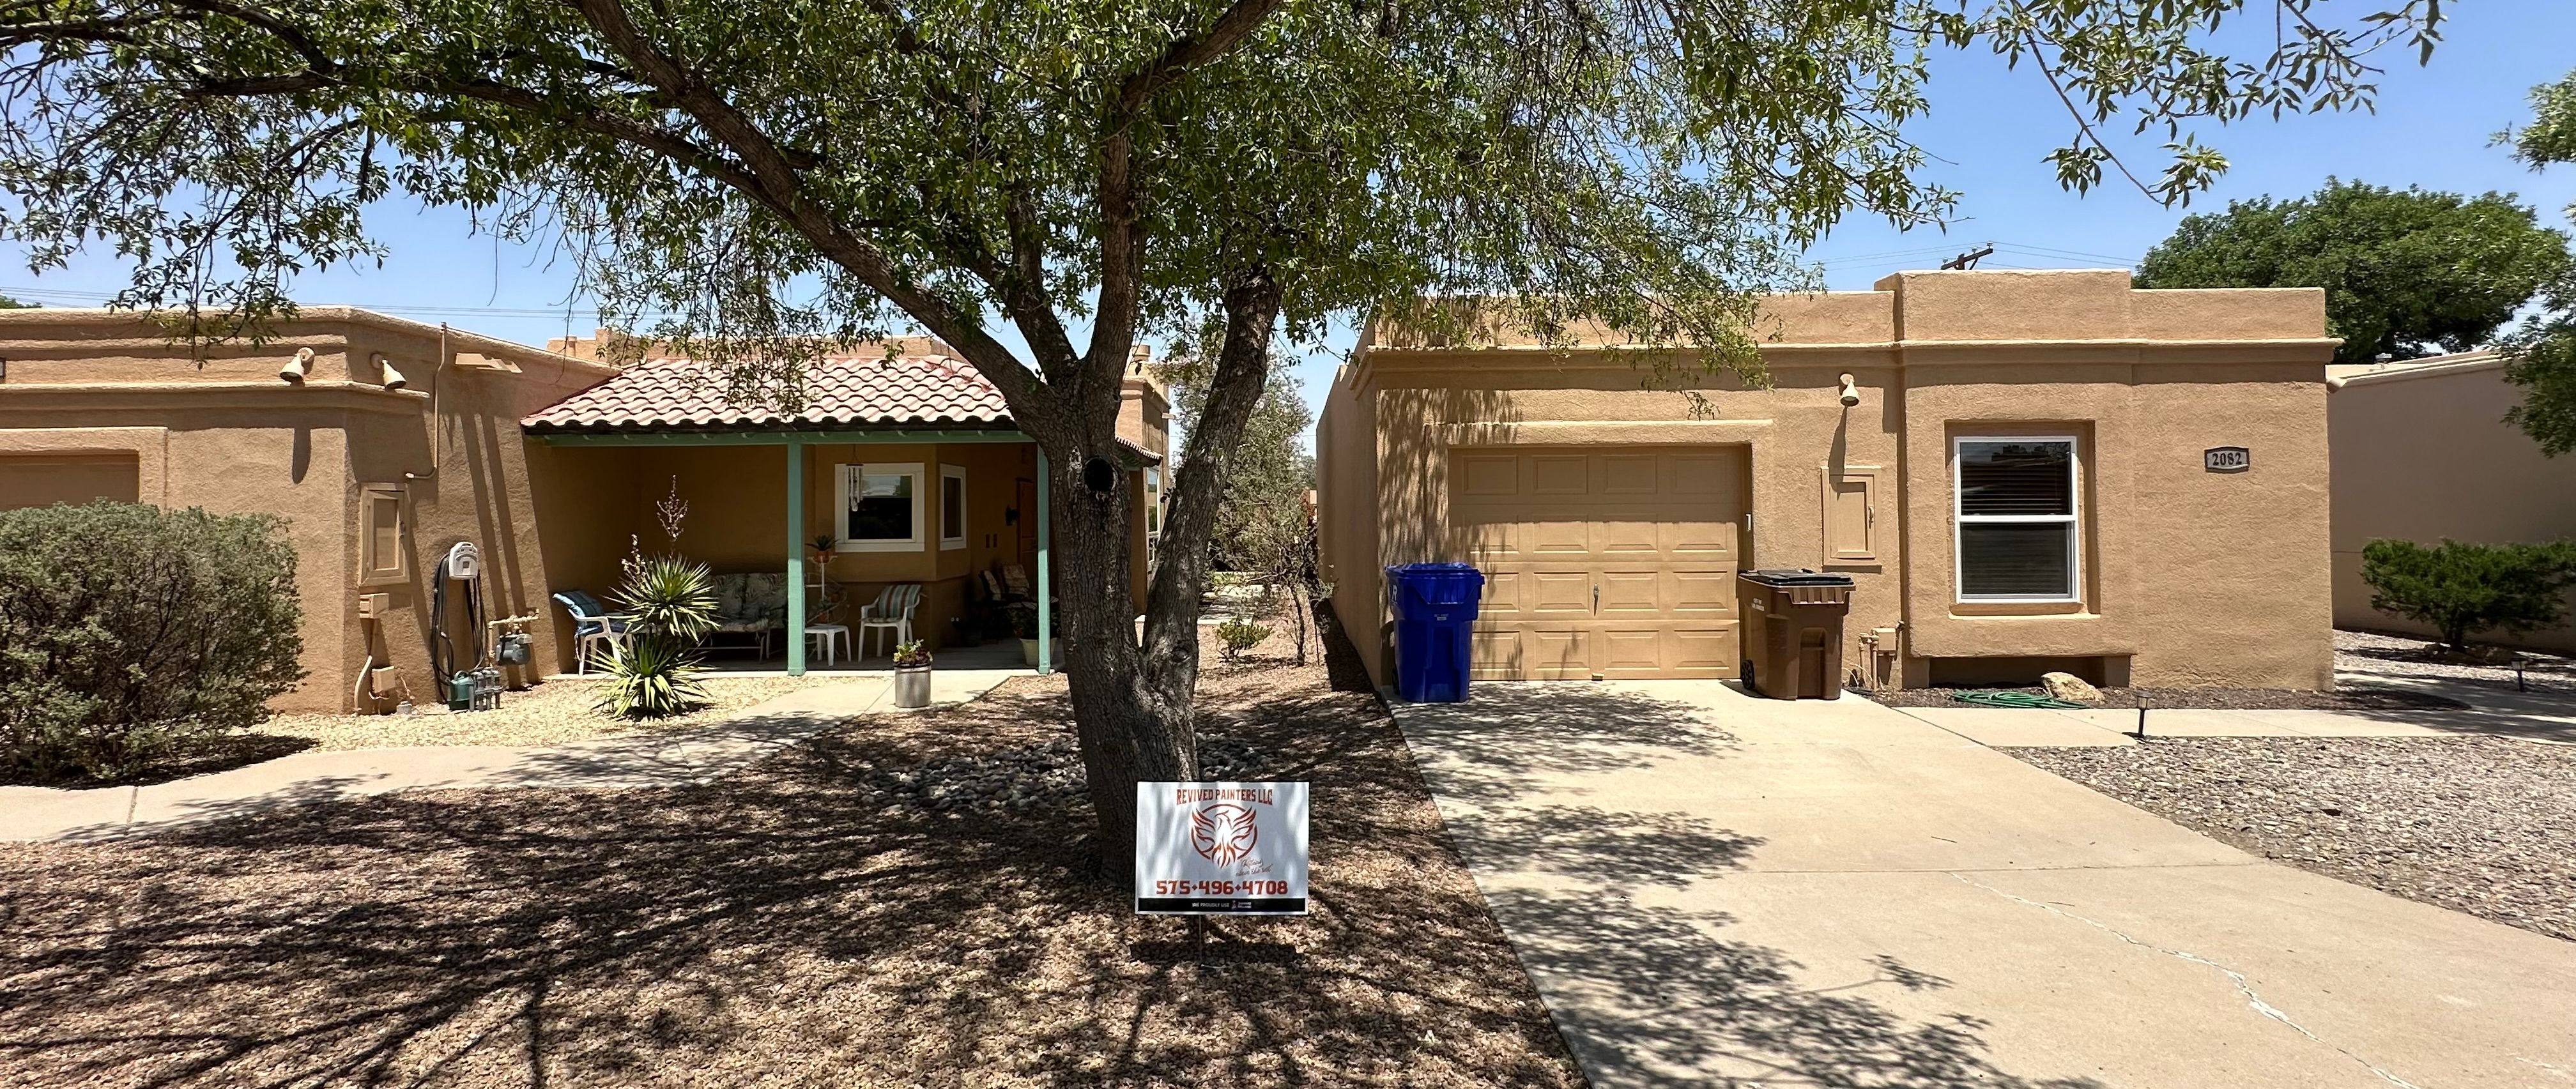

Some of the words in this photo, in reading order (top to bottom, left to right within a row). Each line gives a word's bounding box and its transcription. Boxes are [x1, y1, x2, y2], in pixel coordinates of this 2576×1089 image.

[2212, 452, 2242, 466] 2082
[1177, 789, 1213, 805] REVIVED
[1215, 789, 1256, 803] PAINTERS
[1258, 789, 1273, 805] LLC
